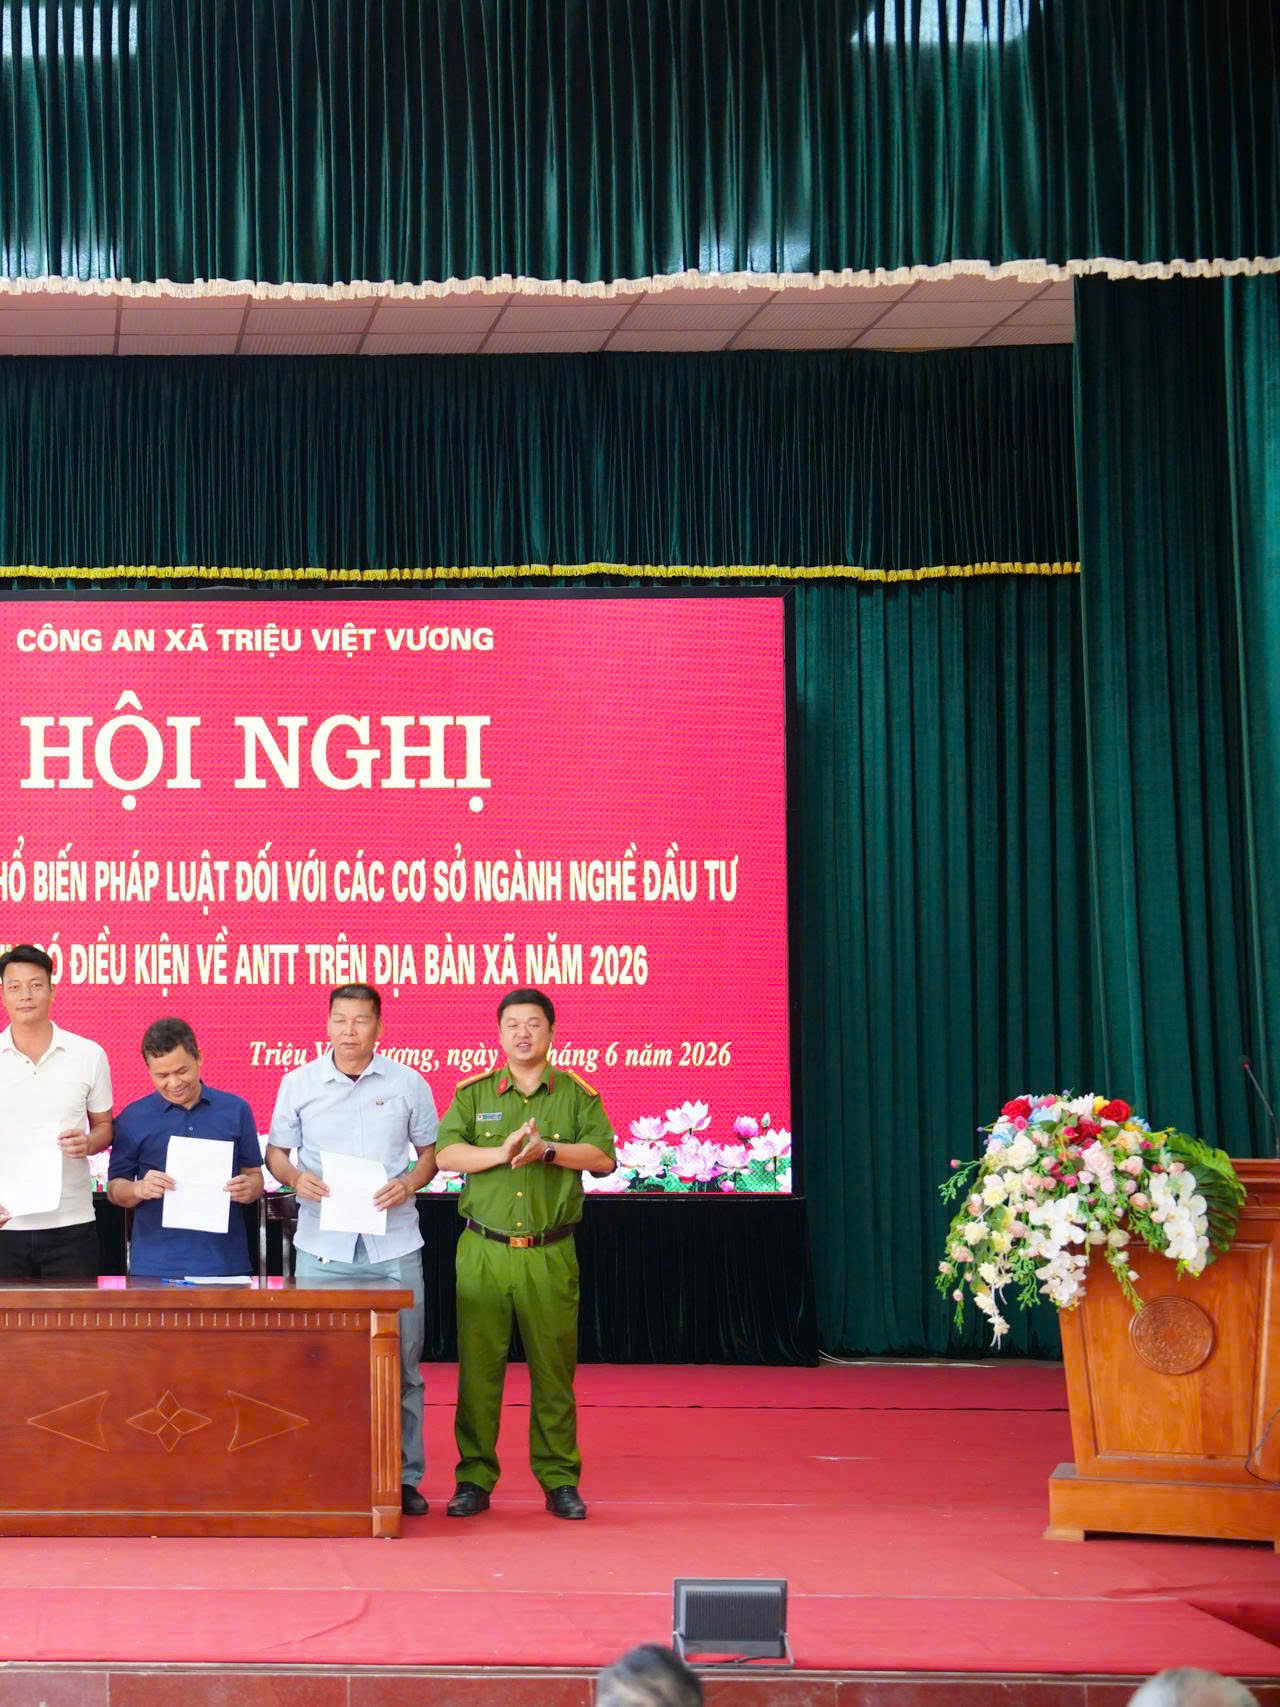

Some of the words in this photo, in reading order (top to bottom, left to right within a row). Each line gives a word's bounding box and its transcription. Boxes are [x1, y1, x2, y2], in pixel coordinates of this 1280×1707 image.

[16, 622, 103, 652] CÔNG
[111, 628, 155, 652] AN
[164, 623, 209, 652] XÃ
[215, 622, 302, 658] TRIỆU
[311, 622, 377, 658] VIỆT
[384, 625, 494, 651] VƯƠNG
[20, 689, 202, 811] HỘI
[234, 713, 492, 813] NGHỊ
[33, 842, 87, 902] BIẾN
[94, 849, 160, 902] PHÁP
[166, 849, 230, 916] LUẬT
[234, 841, 279, 903] ĐỐI
[285, 848, 327, 903] VỚI
[333, 849, 385, 903] CÁC
[391, 858, 427, 903] CƠ
[433, 842, 467, 903] SỞ
[474, 849, 562, 903] NGÀNH
[569, 841, 637, 903] NGHỀ
[642, 841, 697, 902] ĐẦU
[703, 855, 739, 903] TƯ
[69, 925, 127, 985] ĐIỀU
[134, 932, 190, 997] KIỆN
[196, 925, 229, 985] VỀ
[234, 943, 300, 985] ANTT
[304, 932, 367, 985] TRÊN
[373, 943, 418, 998] ĐỊA
[424, 932, 476, 985] BÀN
[482, 932, 519, 985] XÃ
[525, 931, 583, 985] NĂM
[589, 944, 649, 986] 2026
[249, 1041, 308, 1072] Triệu
[373, 1041, 440, 1073] ương,
[446, 1042, 499, 1073] ngày
[546, 1041, 600, 1073] háng
[604, 1041, 620, 1067] 6
[624, 1043, 673, 1067] năm
[678, 1041, 733, 1067] 2026
